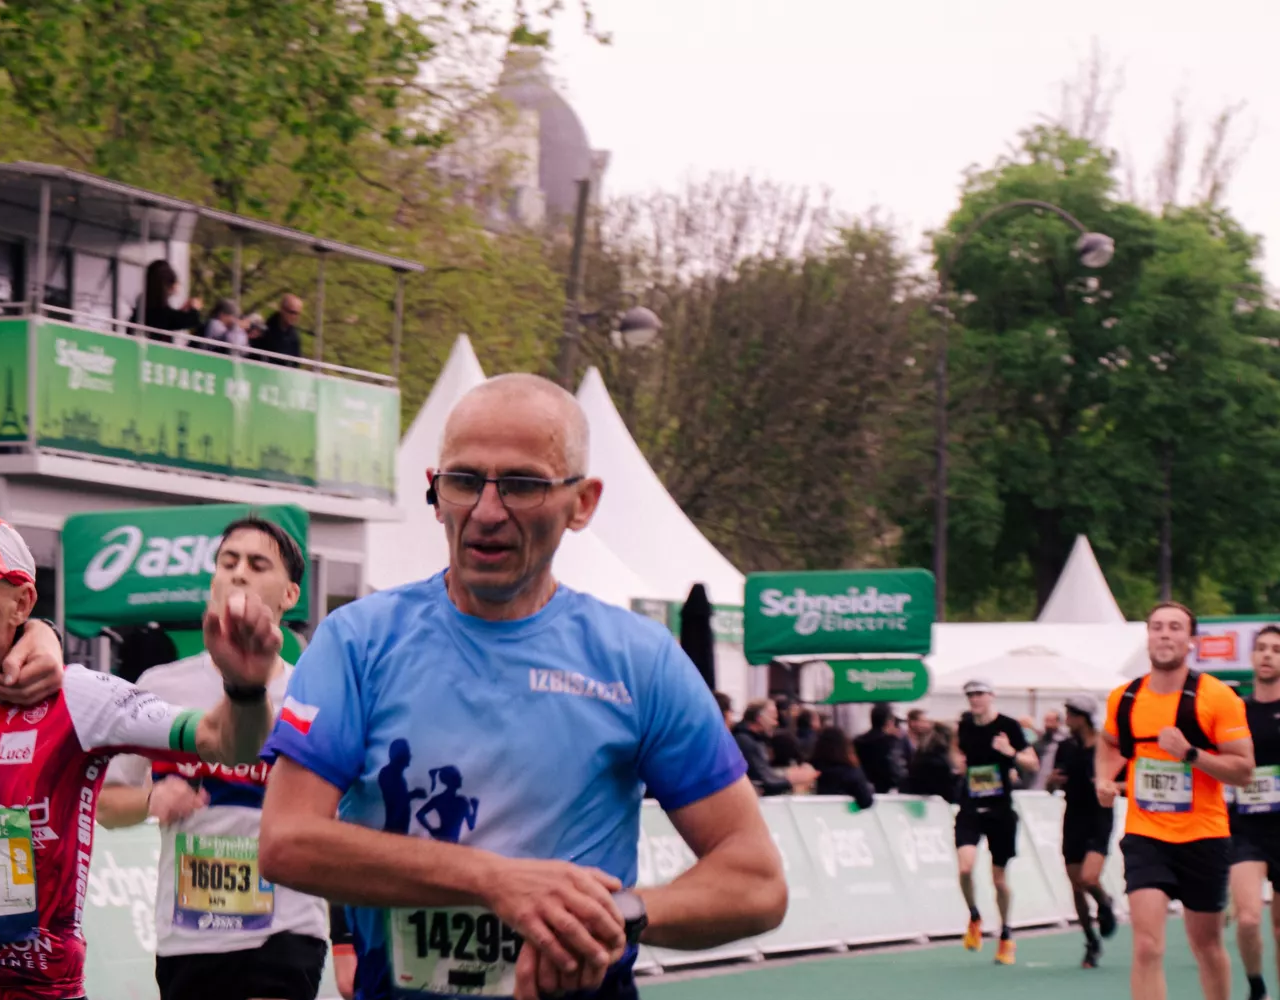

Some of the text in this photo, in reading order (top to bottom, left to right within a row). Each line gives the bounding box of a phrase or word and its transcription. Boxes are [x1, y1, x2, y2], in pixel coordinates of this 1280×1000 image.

[141, 360, 216, 396] ESPACE
[136, 534, 223, 577] asic
[759, 586, 912, 618] Schneider
[821, 616, 908, 632] Electric
[78, 786, 94, 847] CLUB
[189, 860, 251, 893] 16053
